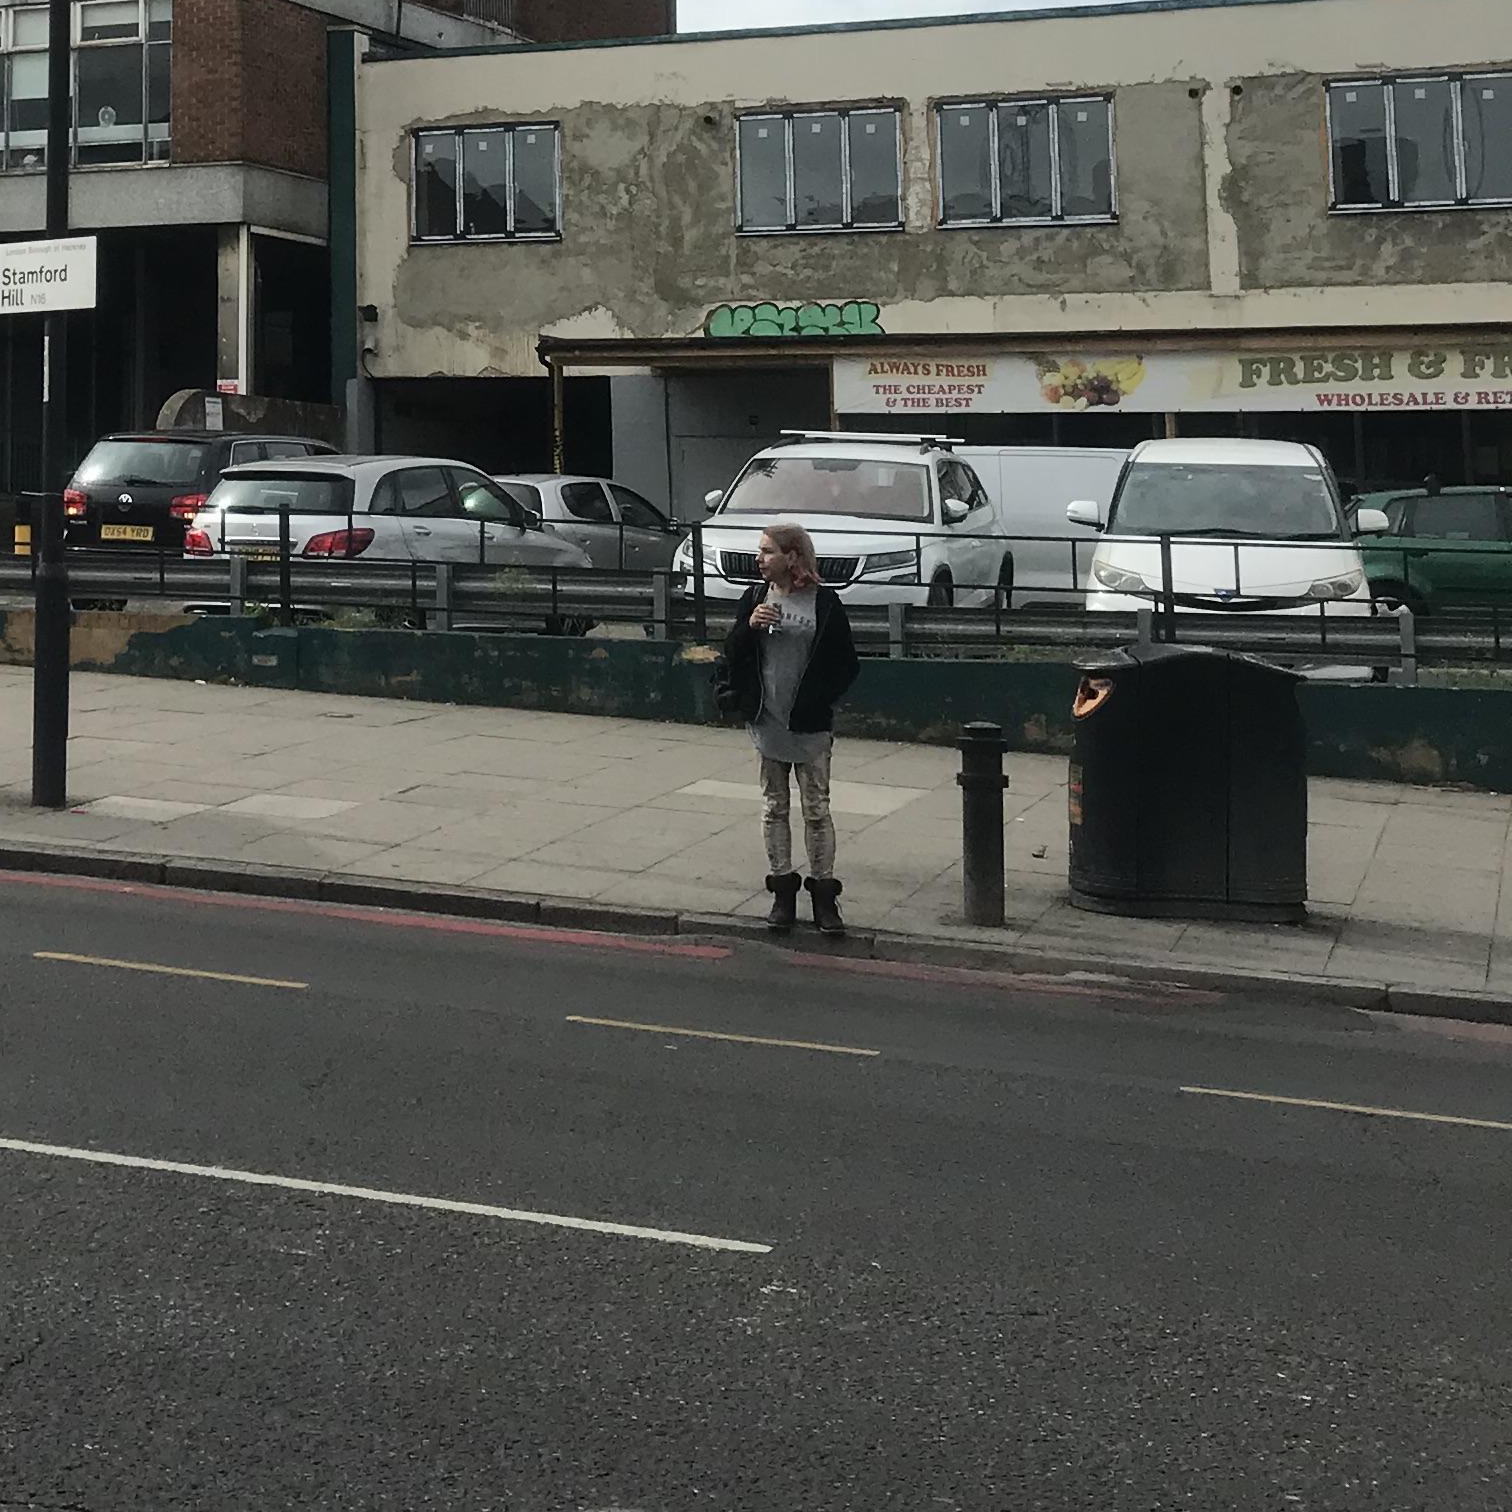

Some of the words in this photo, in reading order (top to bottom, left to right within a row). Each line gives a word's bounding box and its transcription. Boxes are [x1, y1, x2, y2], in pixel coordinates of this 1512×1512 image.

[2, 264, 68, 286] Stamford
[1, 288, 25, 307] Hill
[30, 293, 47, 305] N16
[868, 361, 931, 376] ALWAYS
[935, 363, 988, 377] FRESH
[1238, 351, 1394, 388] FRESH
[1407, 350, 1447, 379] &
[873, 384, 902, 395] THE
[906, 384, 985, 395] CHEAPEST
[885, 397, 897, 408] &
[901, 397, 931, 408] THE
[935, 397, 973, 408] BEST
[1315, 391, 1447, 407] WHOLESALE
[1453, 391, 1470, 405] &
